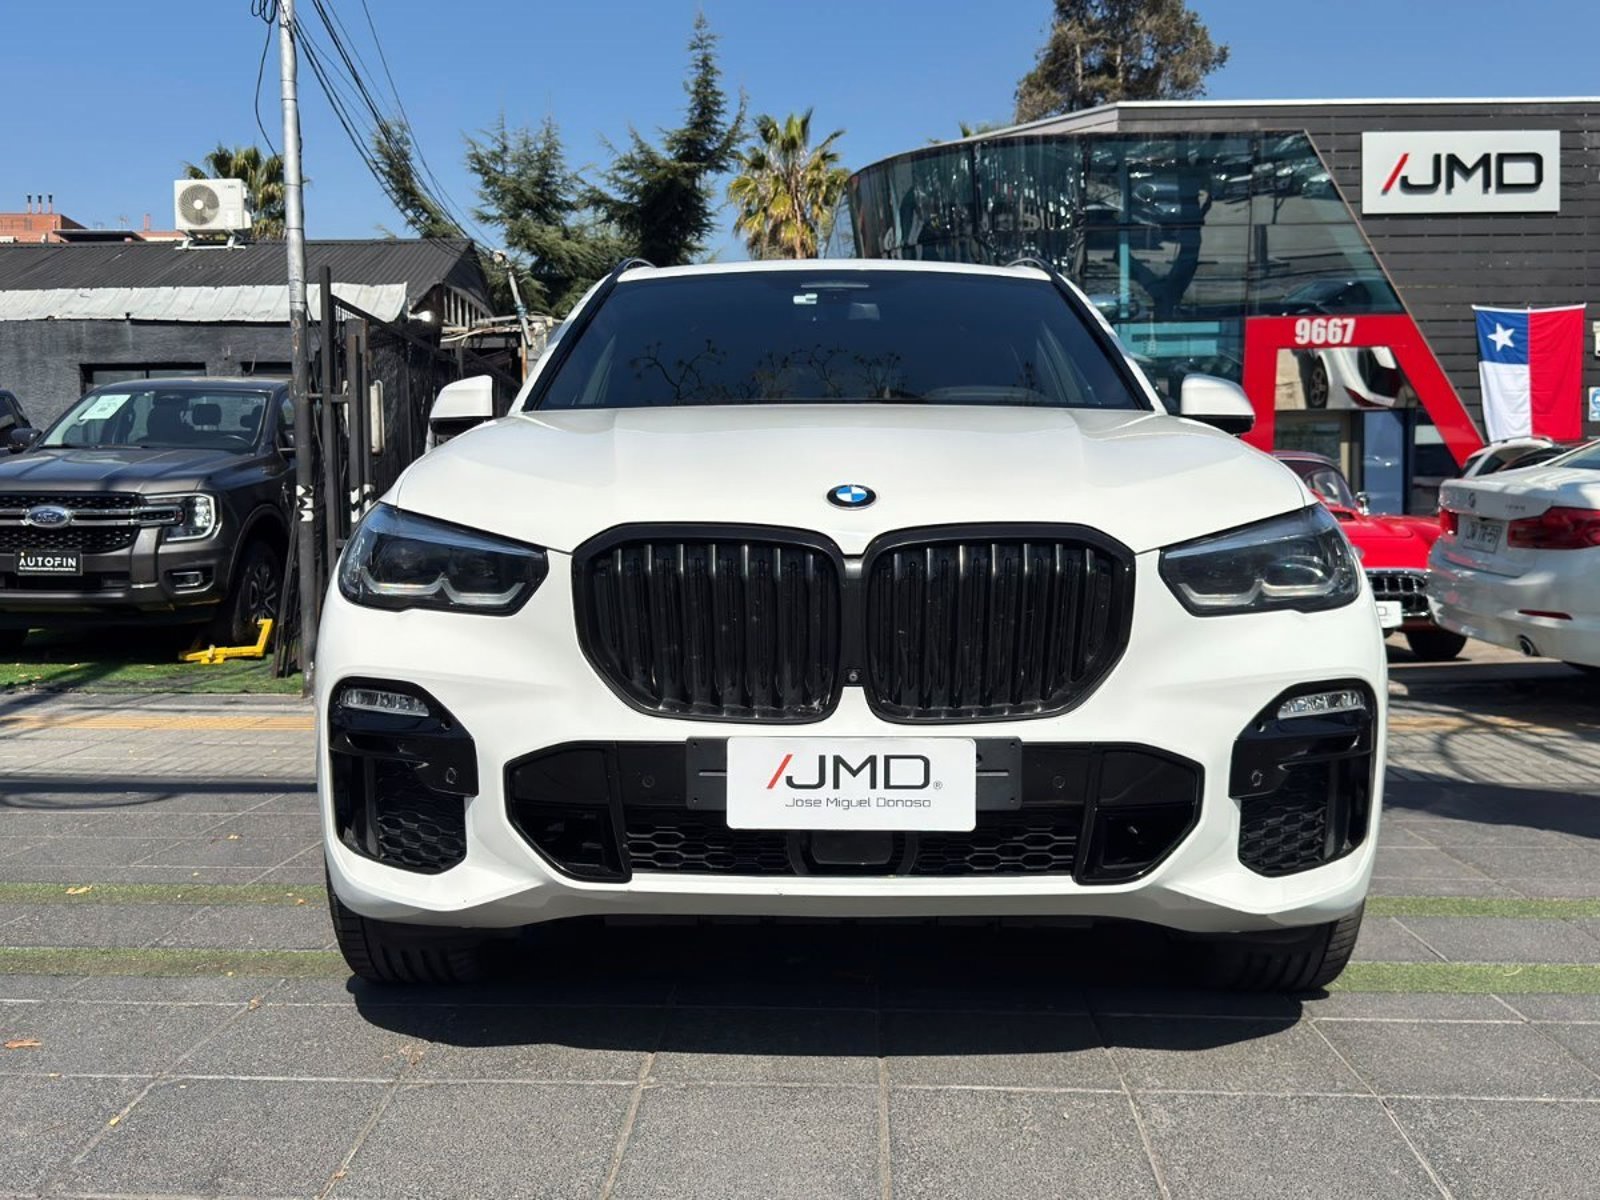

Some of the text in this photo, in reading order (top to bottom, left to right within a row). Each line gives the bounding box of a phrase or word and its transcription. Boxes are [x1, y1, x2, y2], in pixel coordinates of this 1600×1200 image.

[1295, 317, 1355, 345] 9667
[19, 555, 77, 567] AUTOFIN
[785, 796, 931, 810] Jose Miguel Donoso
